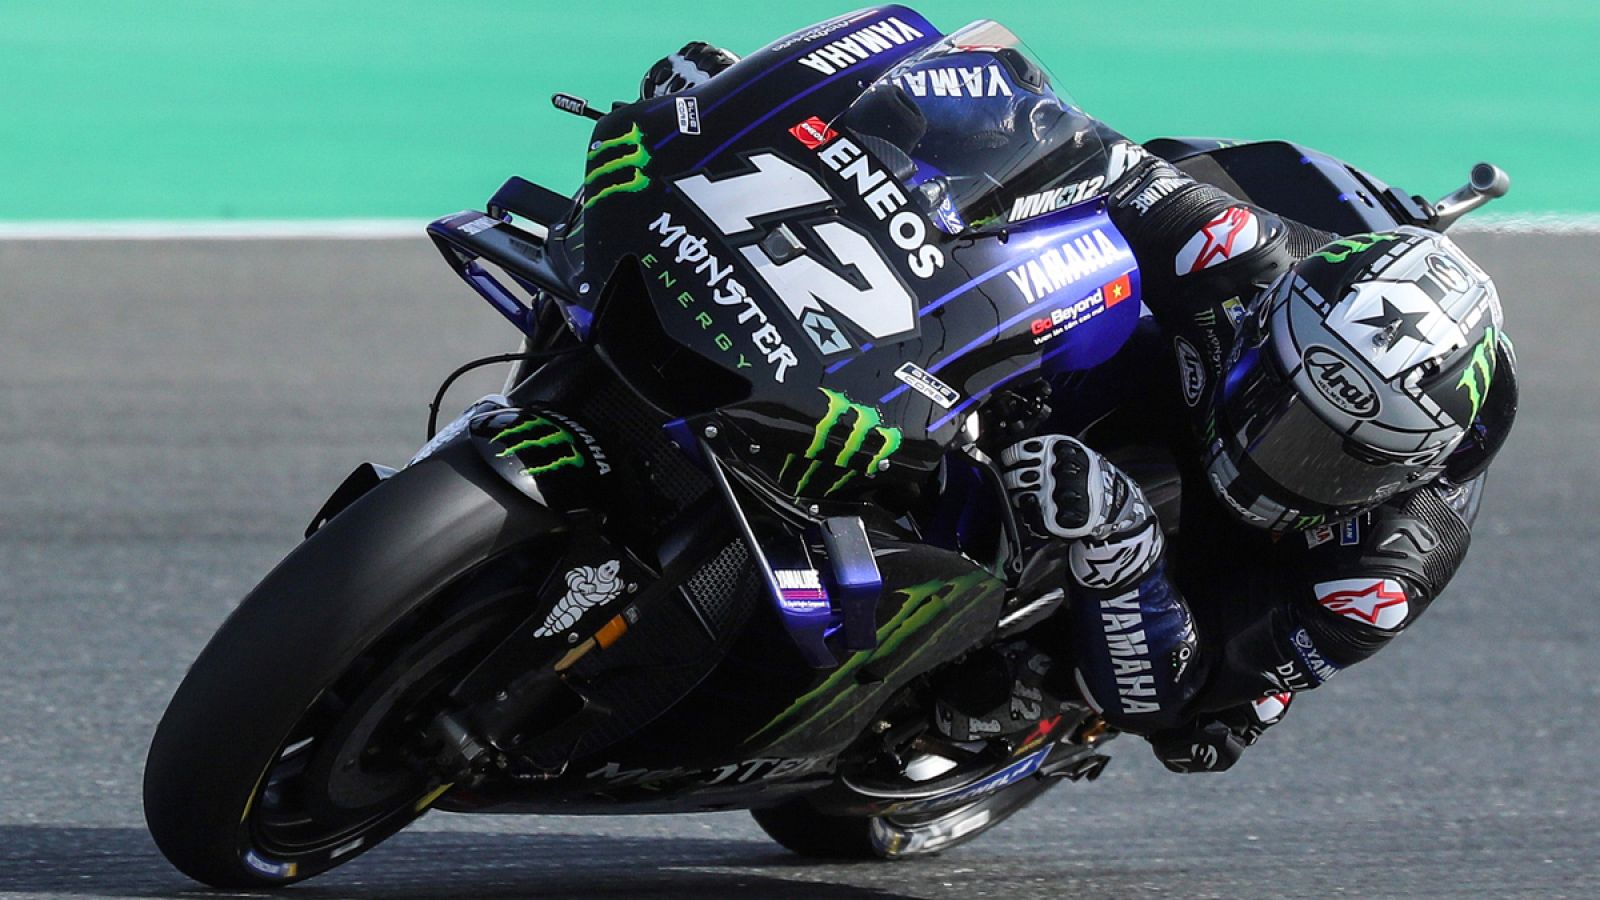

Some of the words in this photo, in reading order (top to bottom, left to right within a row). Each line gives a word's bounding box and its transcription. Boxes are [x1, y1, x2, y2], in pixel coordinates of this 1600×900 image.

[798, 17, 924, 75] YAMAHA
[554, 95, 581, 113] MVK
[674, 153, 915, 338] 12
[819, 137, 945, 278] ENEOS
[641, 254, 752, 368] ENERGY
[648, 212, 798, 383] MONSTER
[1006, 228, 1117, 304] YAMAHA
[1304, 358, 1377, 411] Arai
[1100, 588, 1160, 714] YAMAHA
[1307, 648, 1339, 681] YAM
